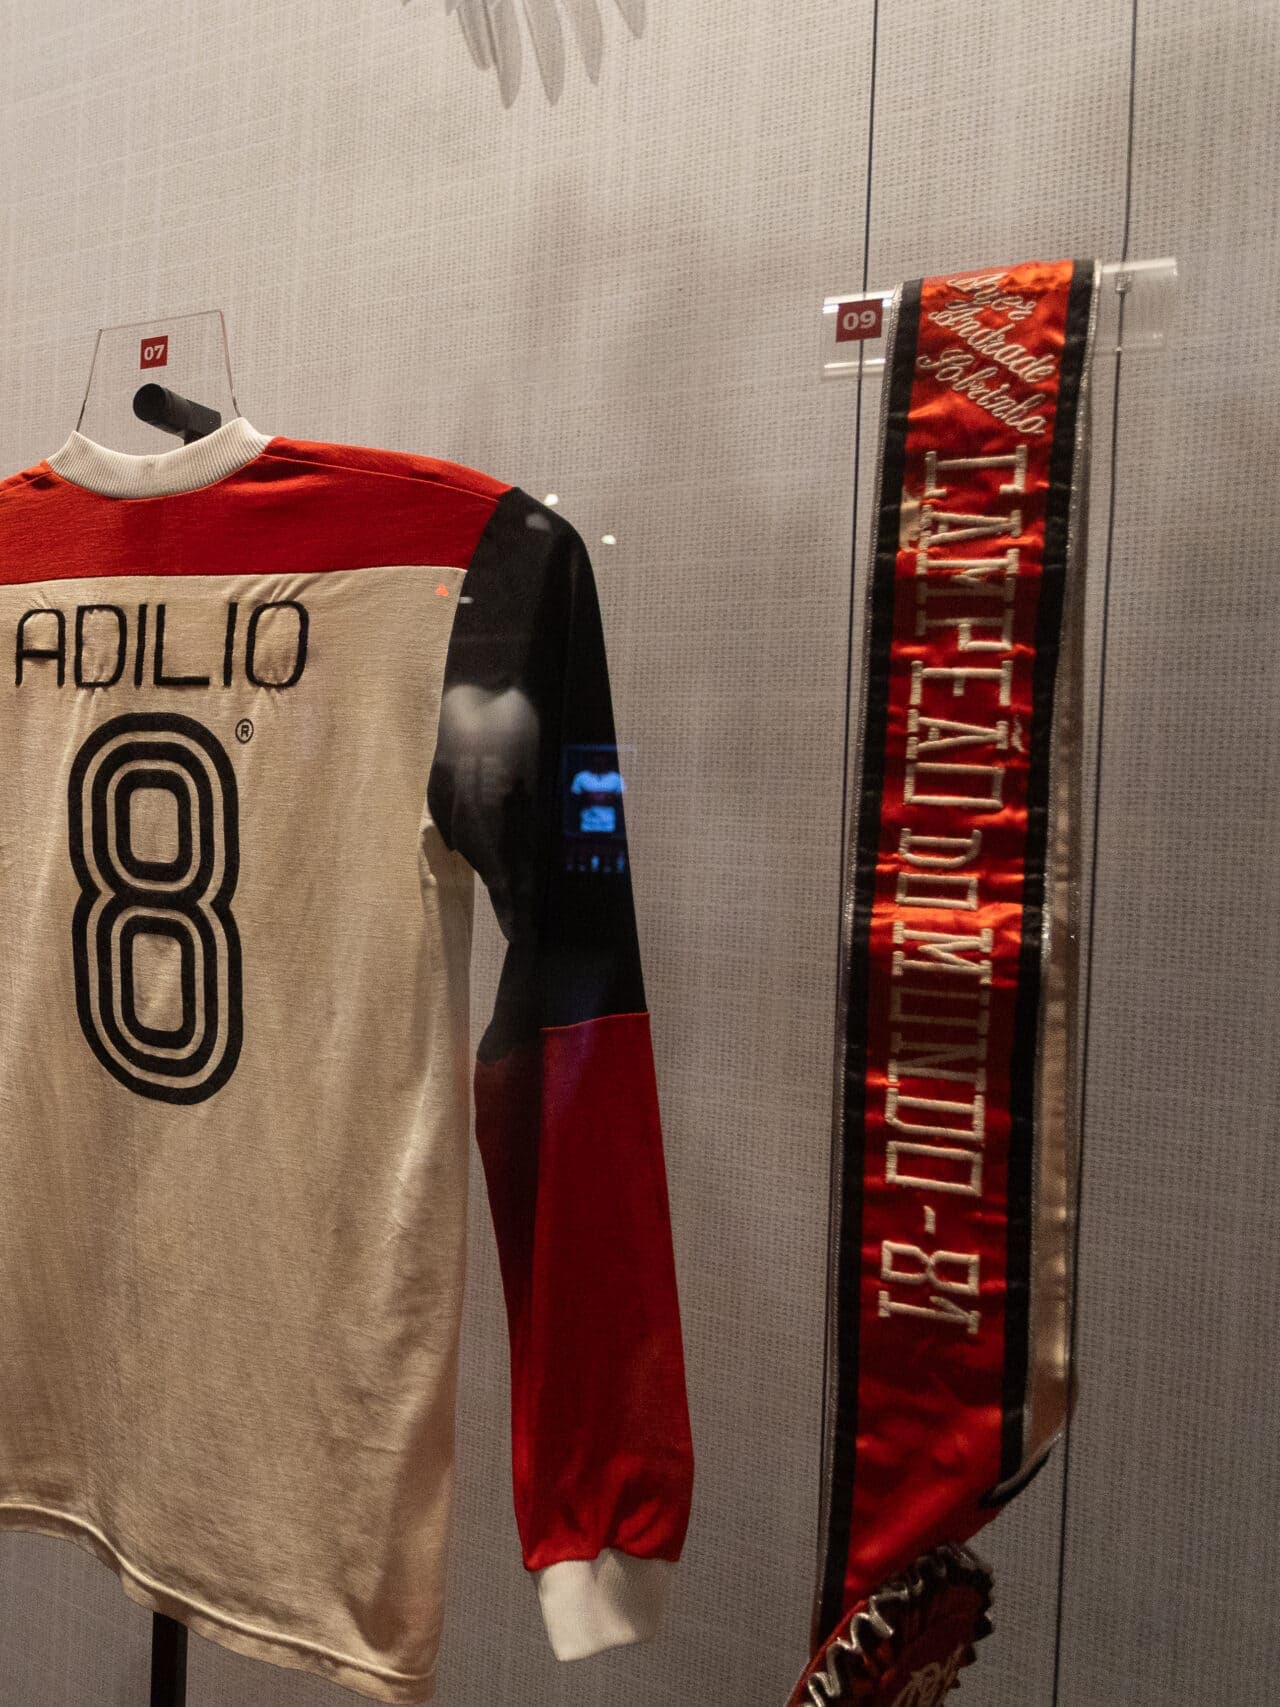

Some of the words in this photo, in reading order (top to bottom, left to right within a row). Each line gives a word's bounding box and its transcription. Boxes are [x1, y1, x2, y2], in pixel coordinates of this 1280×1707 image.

[143, 344, 166, 361] 07
[842, 309, 877, 332] 09
[928, 302, 1058, 383] Andrade
[917, 347, 1048, 434] Sobrinho
[14, 599, 310, 689] ADILIO
[902, 444, 1029, 810] CAMPEÃO
[67, 711, 245, 1106] 8
[895, 827, 983, 911] DO
